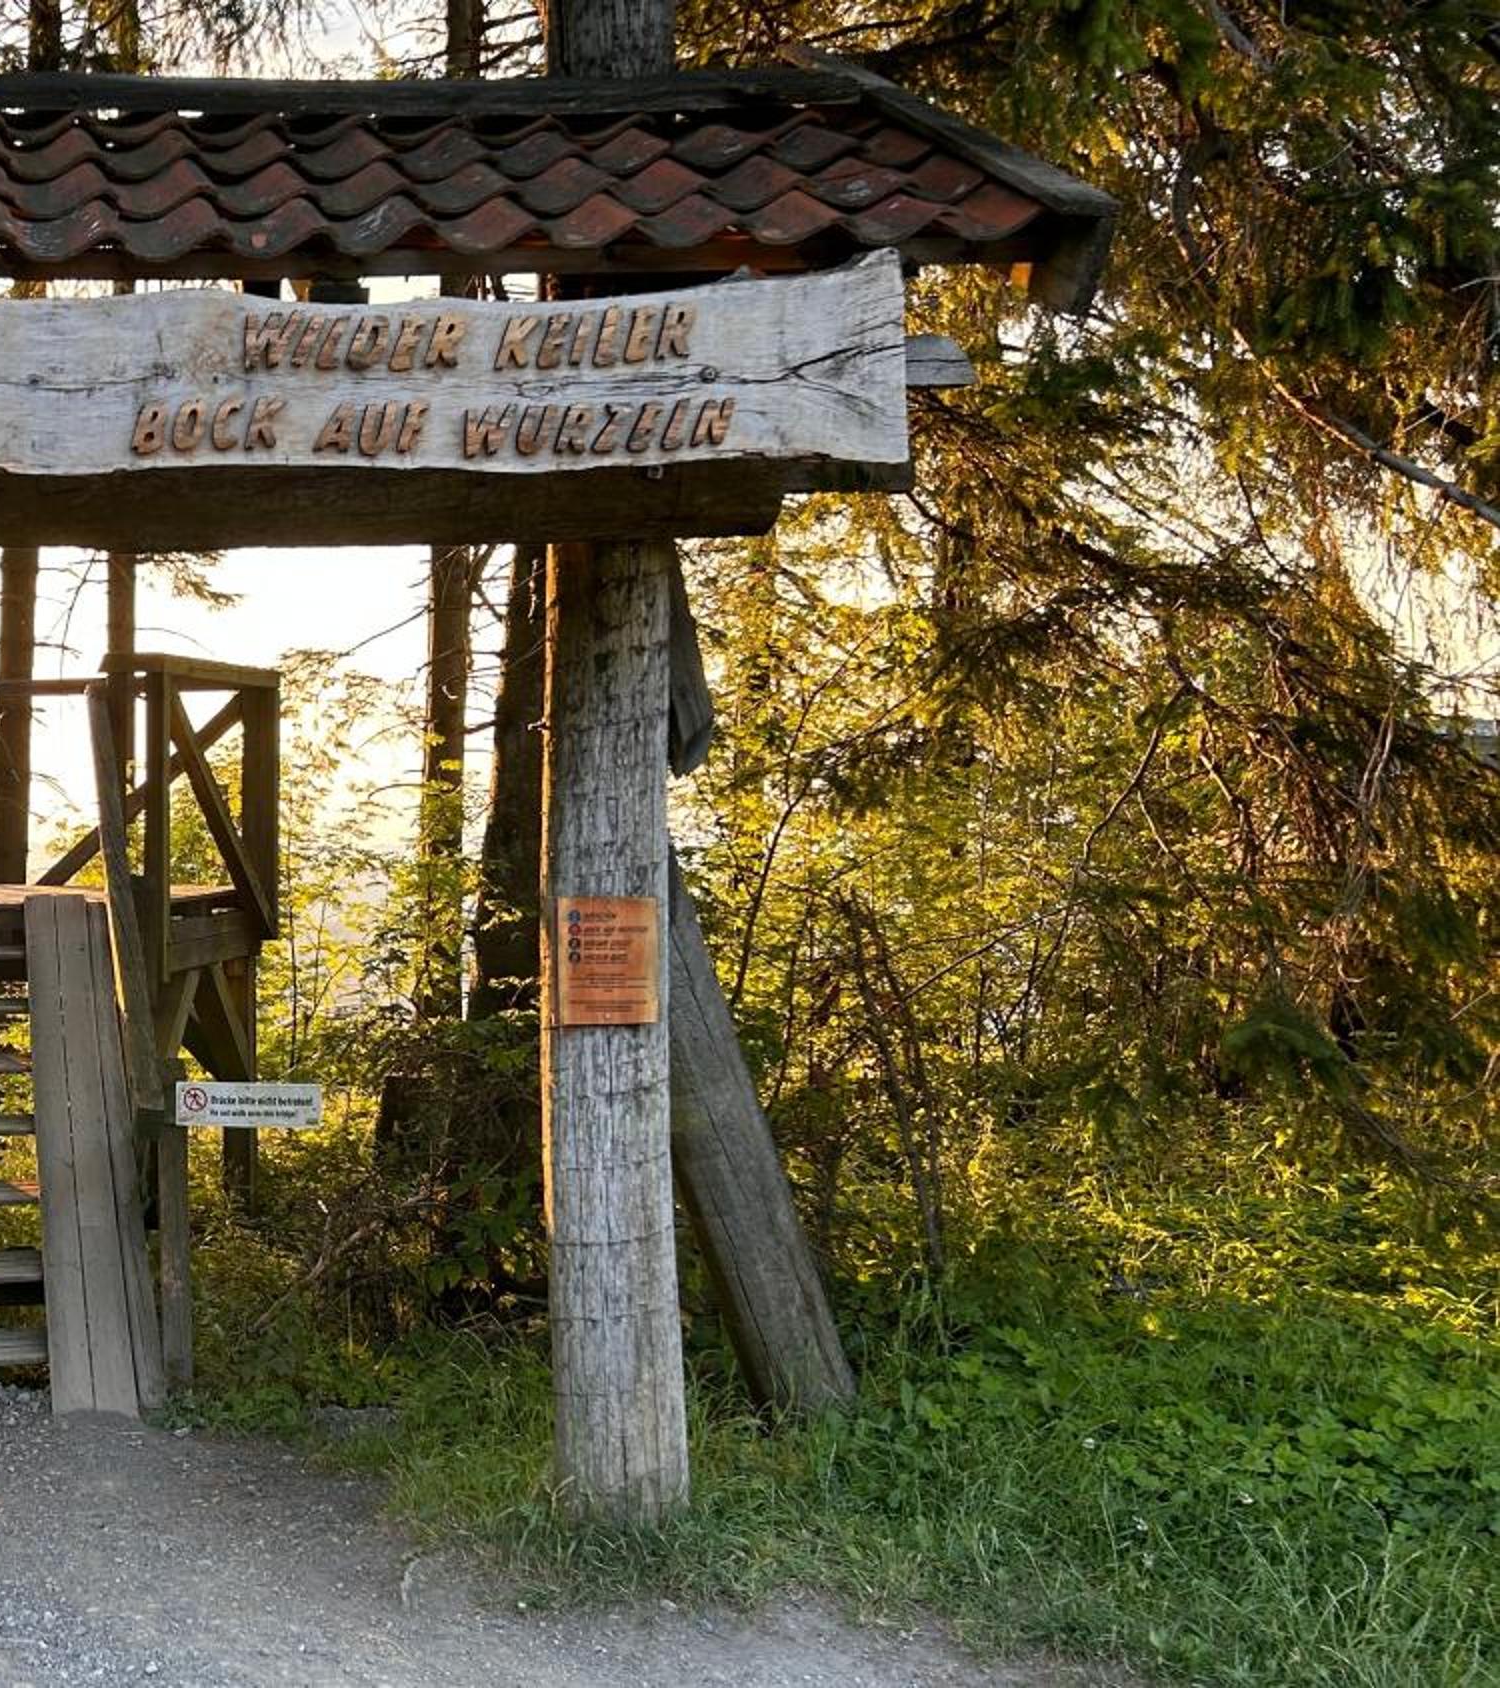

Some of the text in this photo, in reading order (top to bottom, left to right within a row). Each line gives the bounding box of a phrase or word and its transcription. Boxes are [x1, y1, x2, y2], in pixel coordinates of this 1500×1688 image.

[243, 301, 696, 373] WILDER KEILER
[131, 398, 736, 460] BOCK AUF WURZELN
